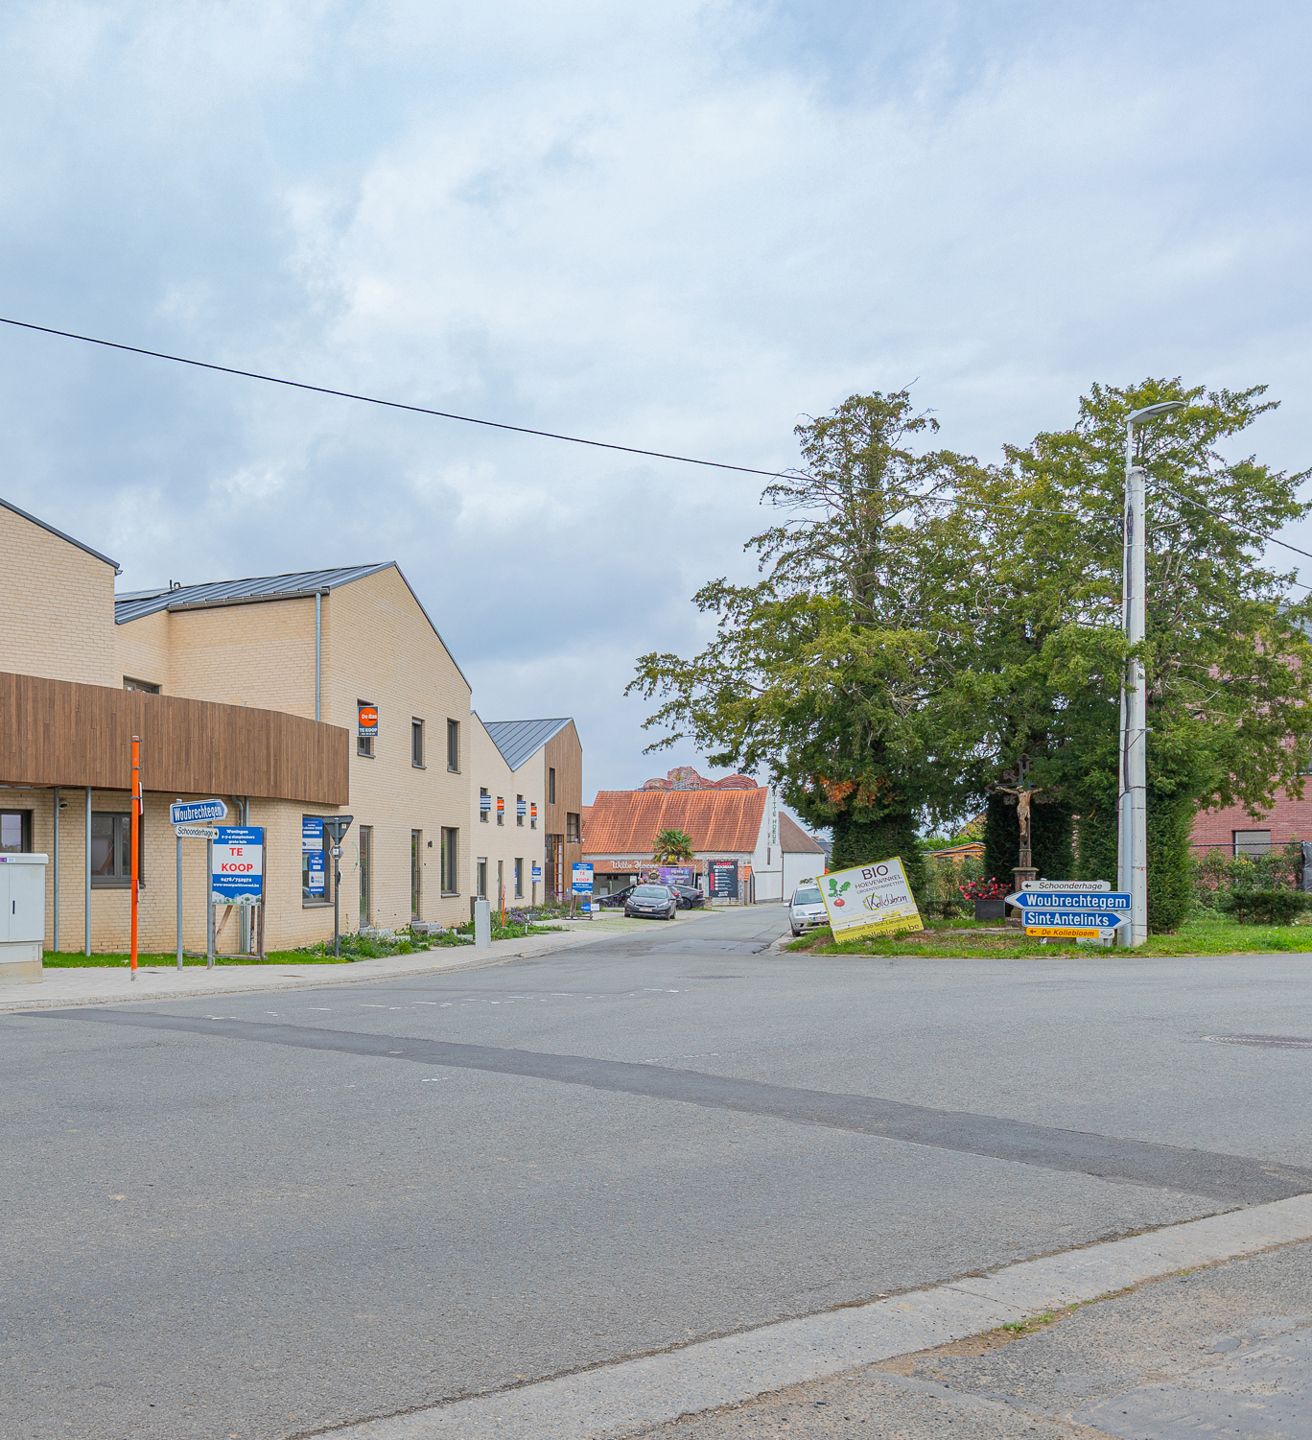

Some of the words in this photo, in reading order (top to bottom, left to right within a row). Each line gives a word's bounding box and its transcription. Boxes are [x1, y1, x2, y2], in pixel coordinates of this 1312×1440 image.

[174, 805, 223, 821] Woubrechtegem
[177, 826, 213, 837] Schoonderhage
[229, 848, 243, 856] TE
[221, 863, 253, 872] KOOP
[861, 865, 888, 880] BIO
[854, 875, 903, 889] HOEVEWINKEL
[1039, 882, 1102, 890] Schoonderhage
[1026, 895, 1126, 910] Woubrechtegem
[1028, 913, 1109, 926] Sint-Antelinks
